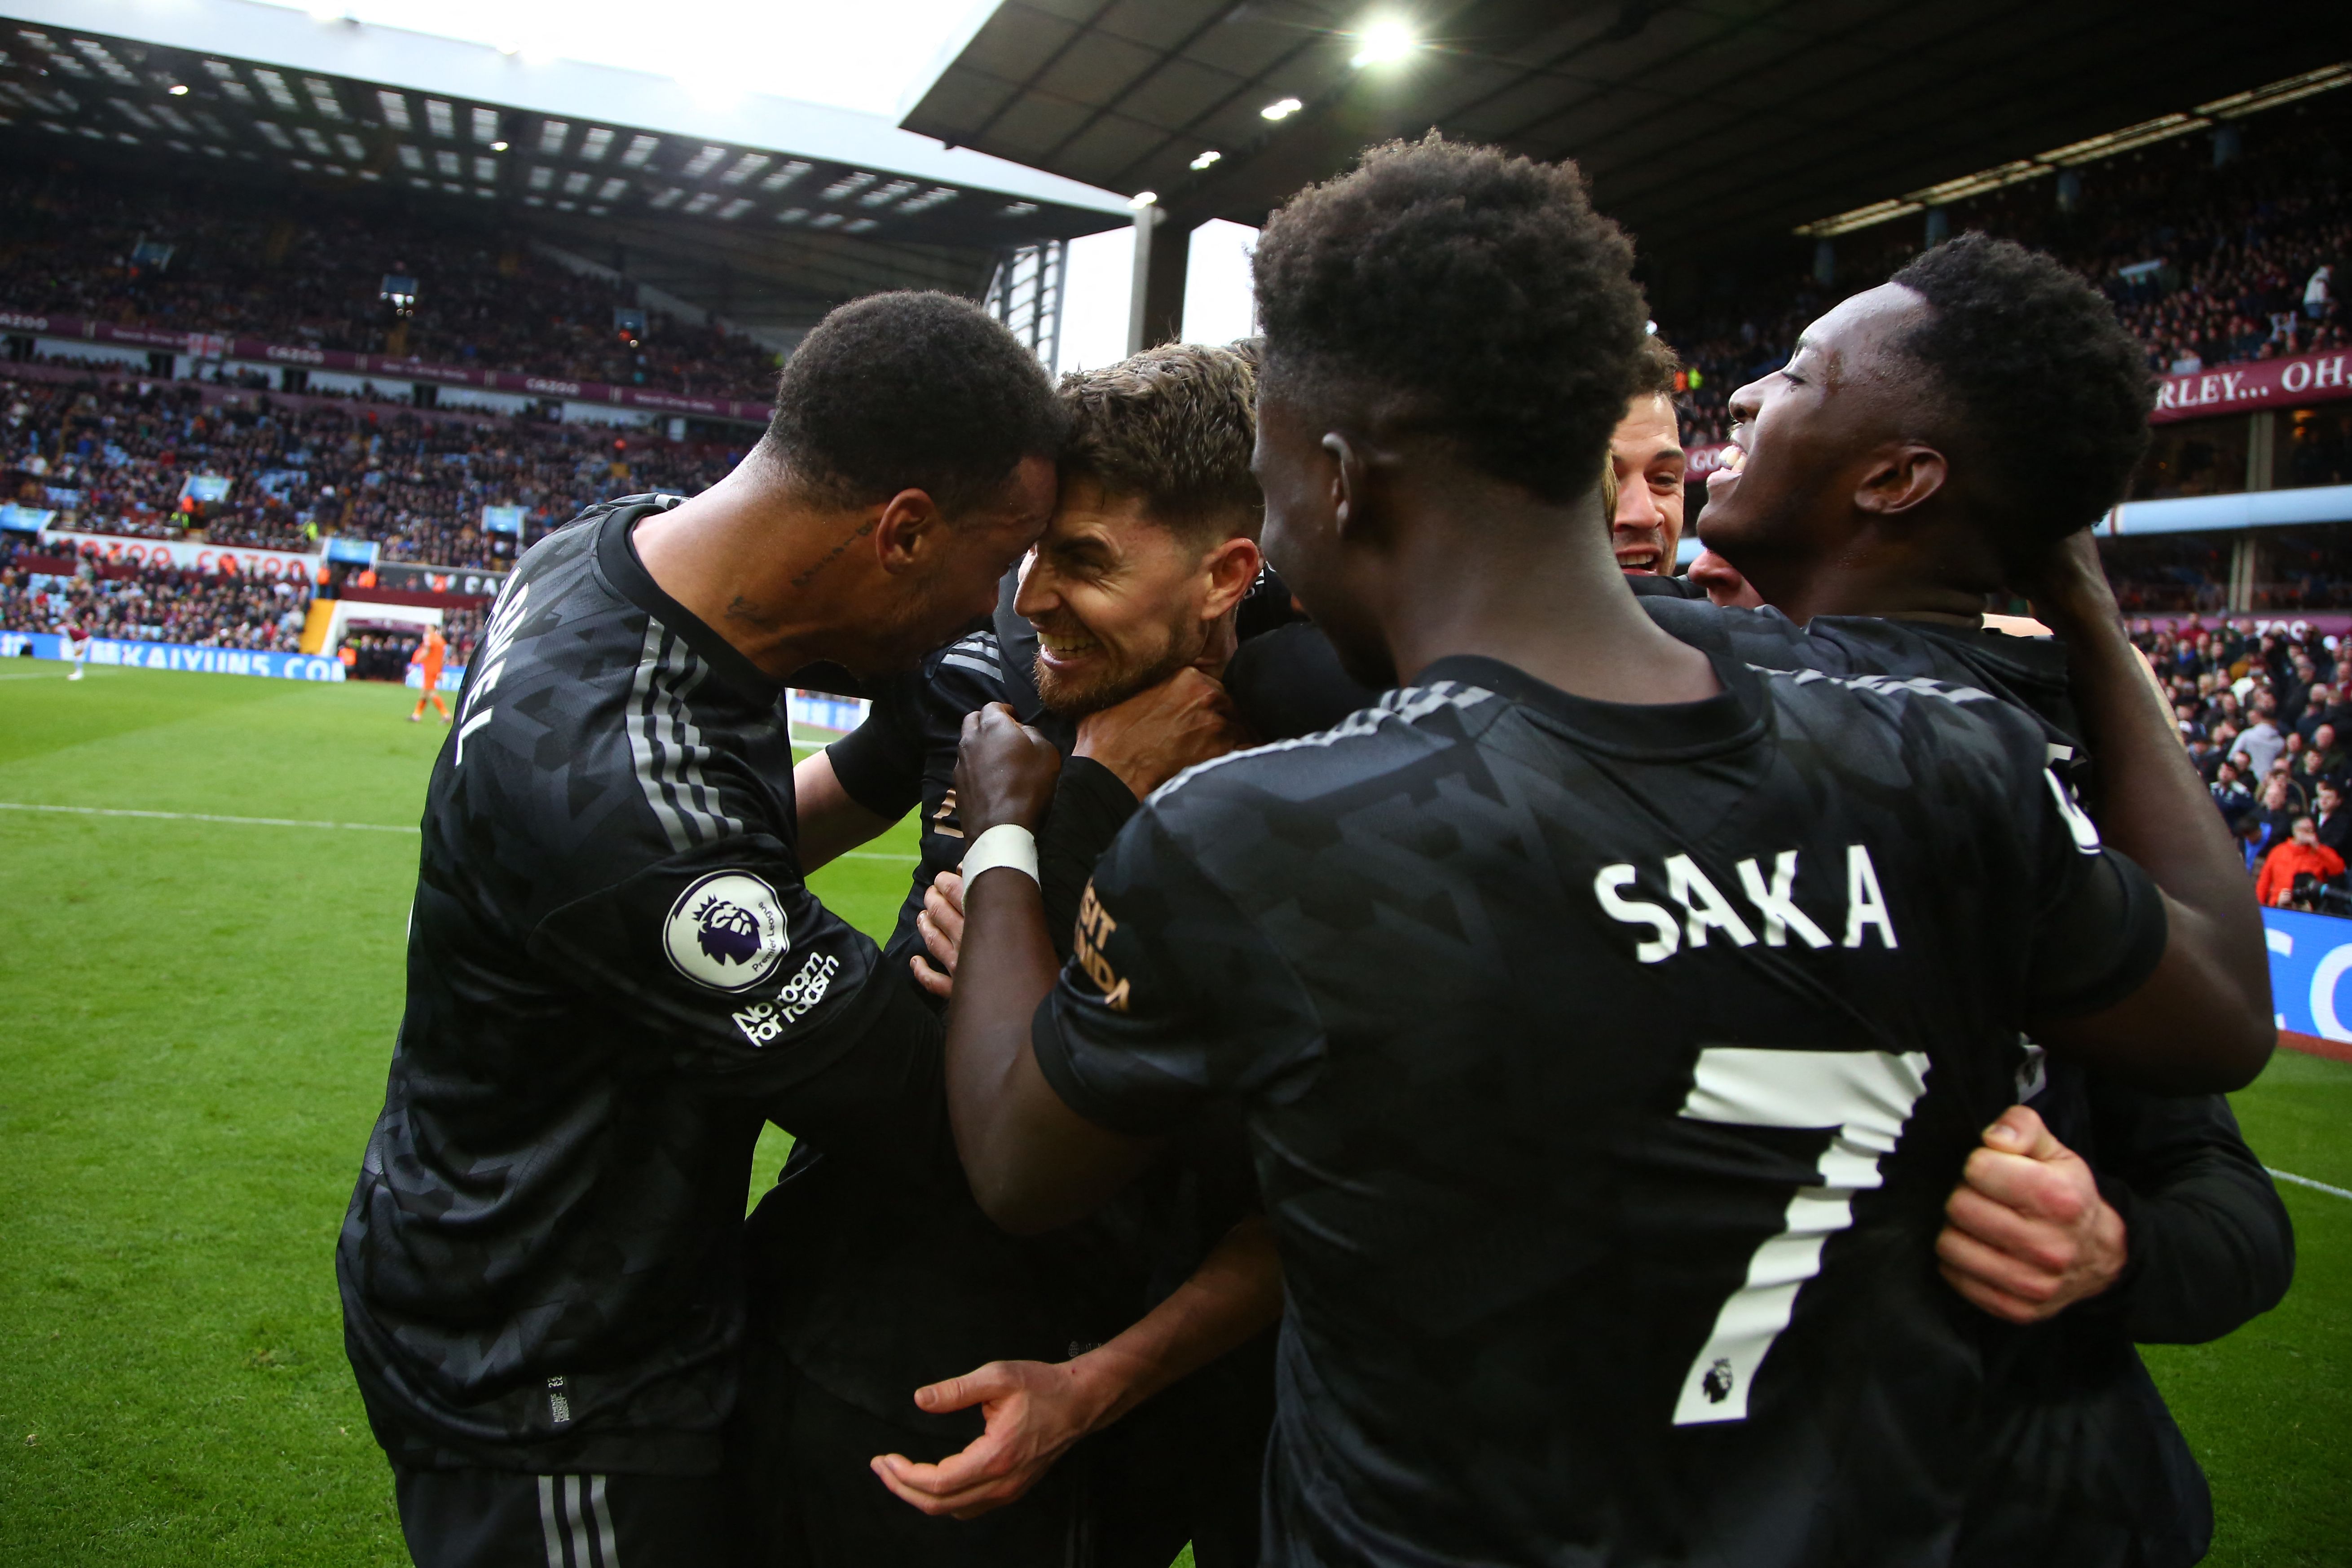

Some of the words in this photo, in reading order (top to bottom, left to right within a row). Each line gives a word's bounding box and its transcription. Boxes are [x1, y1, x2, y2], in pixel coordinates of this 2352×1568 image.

[758, 902, 775, 937] League
[1594, 844, 1898, 964] SAKA
[731, 1002, 773, 1033] No
[772, 951, 823, 1007] room
[752, 938, 776, 972] Premier
[746, 1013, 783, 1047] for
[782, 955, 840, 1024] racism
[1672, 1047, 1931, 1426] 7
